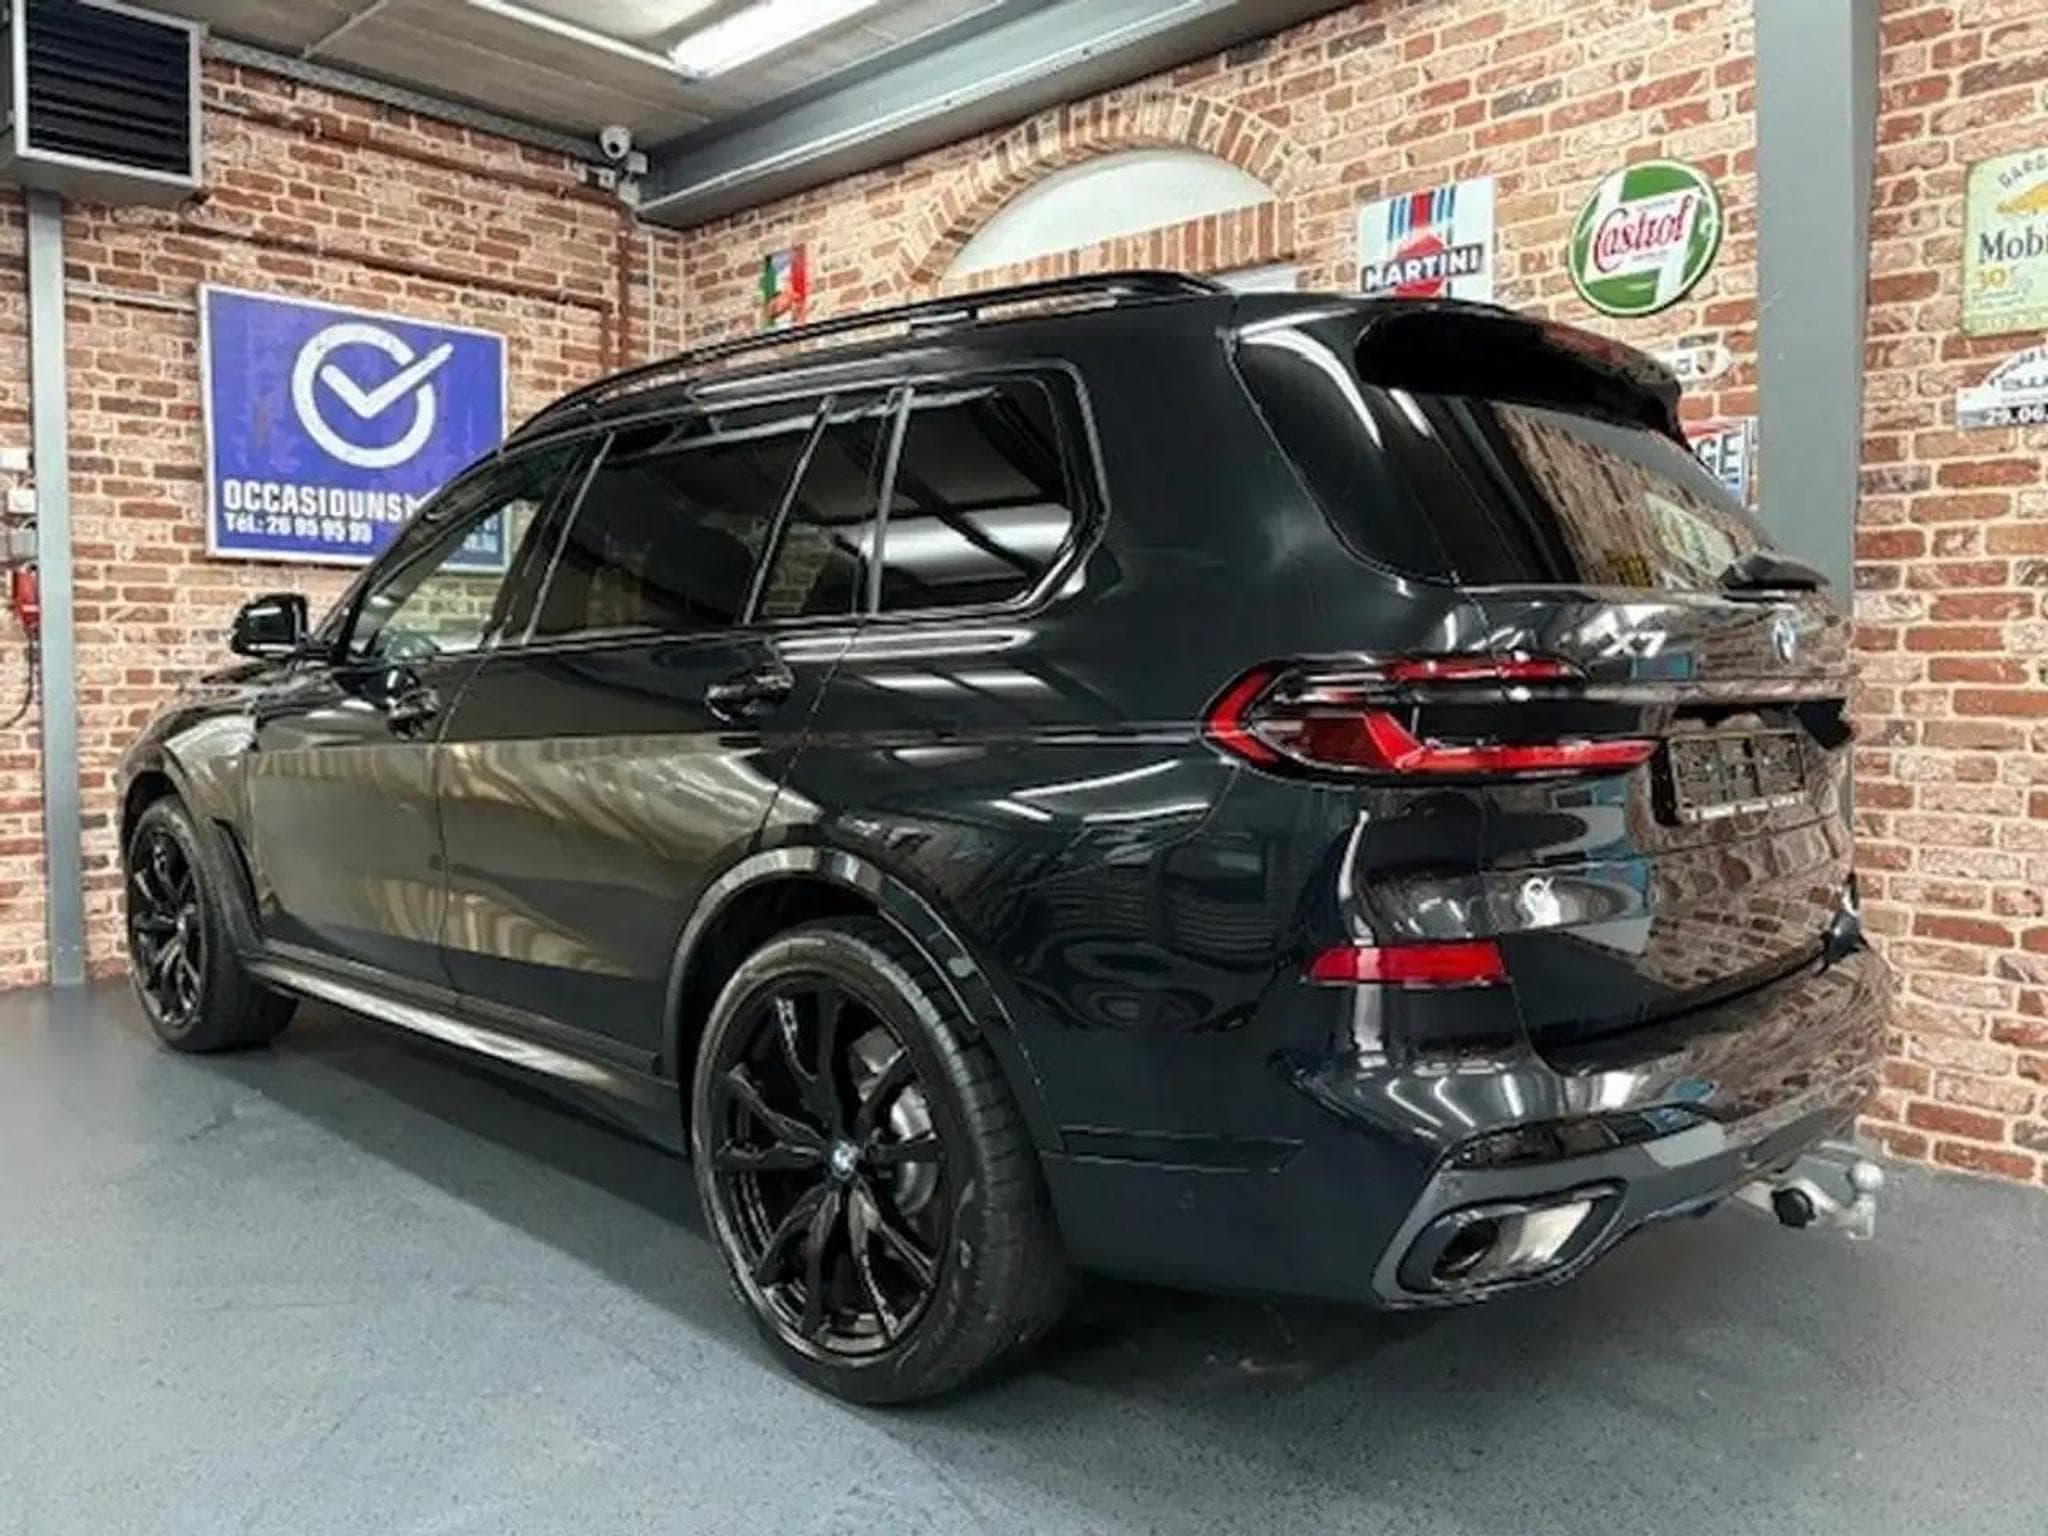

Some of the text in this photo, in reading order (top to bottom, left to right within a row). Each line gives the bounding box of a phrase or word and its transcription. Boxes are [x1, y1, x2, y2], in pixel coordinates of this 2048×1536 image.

[1593, 194, 1694, 274] Castrol
[1978, 225, 2048, 264] Mob
[1362, 245, 1481, 292] MARTINI
[1601, 629, 1666, 658] X7
